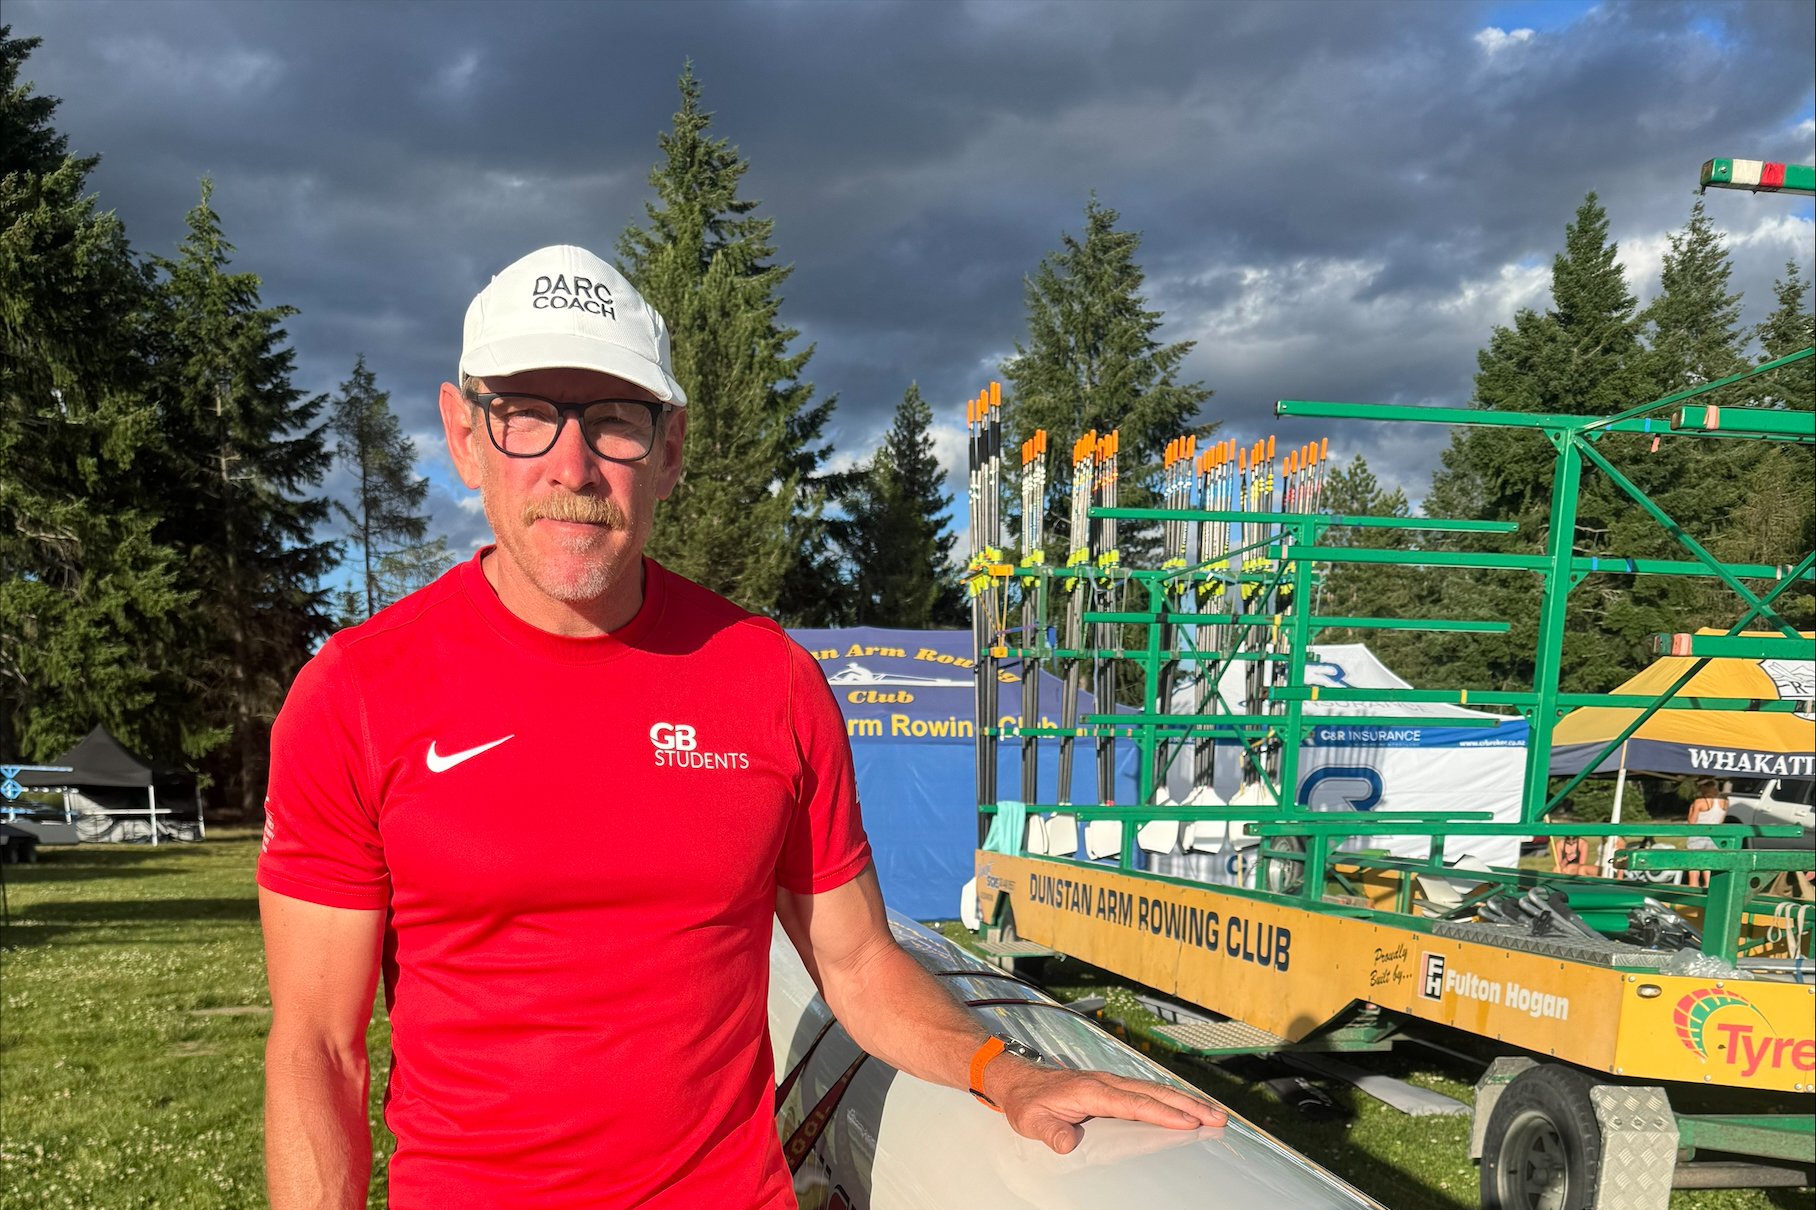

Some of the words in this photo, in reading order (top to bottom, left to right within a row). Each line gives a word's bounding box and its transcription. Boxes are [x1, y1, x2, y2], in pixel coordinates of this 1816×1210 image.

[532, 273, 613, 305] DARC
[532, 295, 616, 321] COACH
[844, 644, 907, 658] Arm
[847, 690, 914, 704] Club
[649, 721, 697, 751] GB
[847, 718, 883, 737] rm
[890, 713, 974, 738] Rowin
[1320, 730, 1346, 741] C&R
[1348, 730, 1421, 742] INSURANCE
[654, 749, 749, 769] STUDENTS
[1688, 748, 1815, 776] WHAKATI
[1029, 873, 1092, 916] DUNSTAN
[1096, 887, 1133, 928] ARM
[1138, 895, 1219, 951] ROWING
[1226, 916, 1291, 972] CLUB
[1374, 944, 1408, 966] Proudly
[1445, 969, 1501, 1004] Fulton
[1505, 981, 1569, 1021] Hogan
